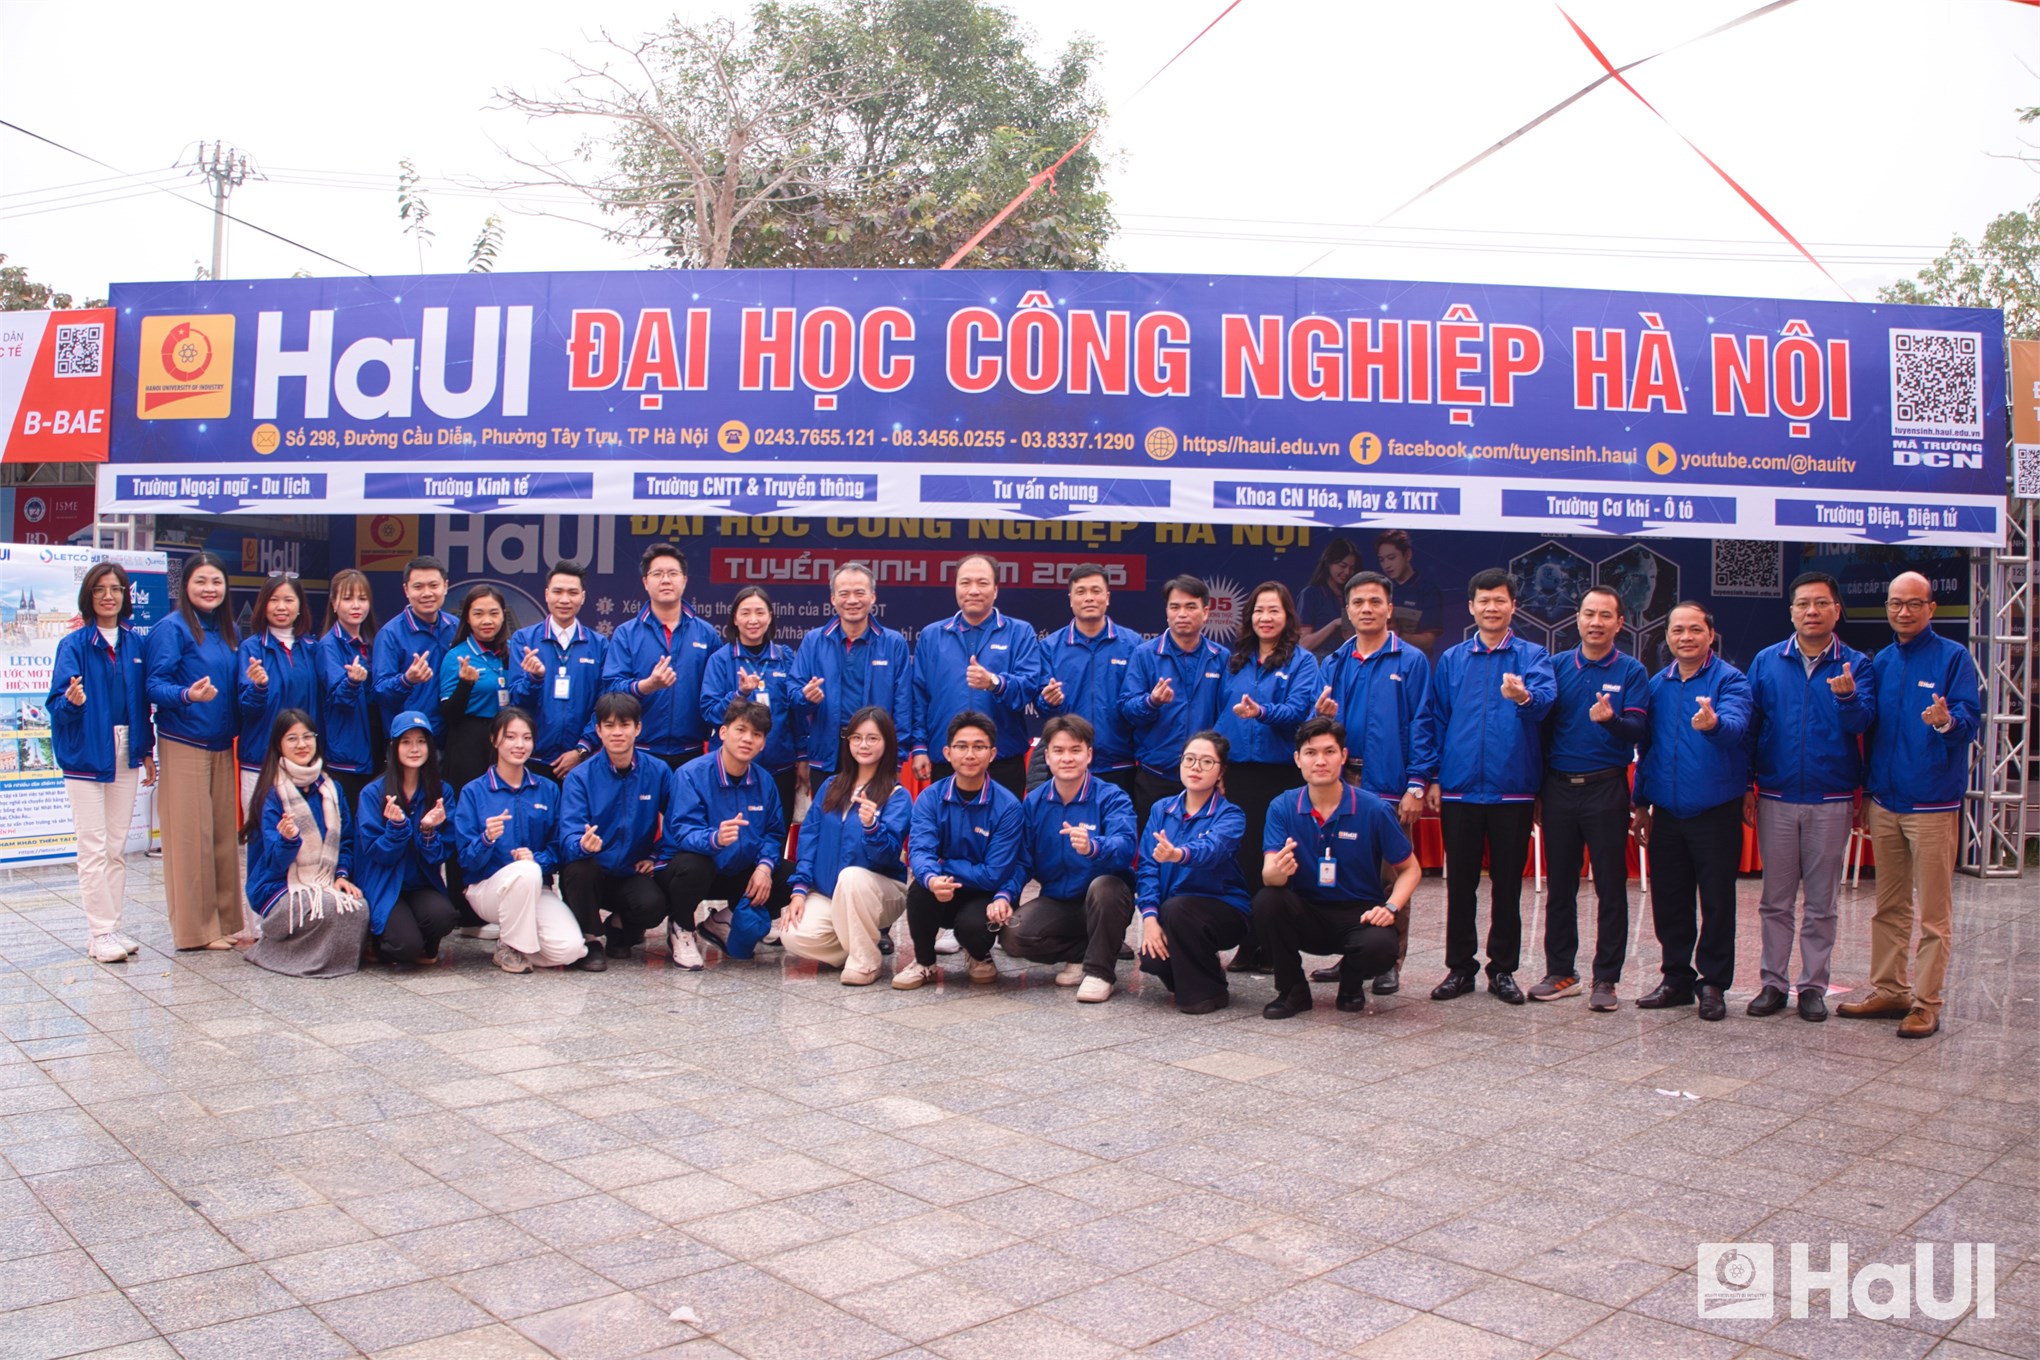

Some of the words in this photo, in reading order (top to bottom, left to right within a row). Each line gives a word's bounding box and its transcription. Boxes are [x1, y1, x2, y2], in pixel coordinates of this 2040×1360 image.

[253, 305, 533, 420] HaUI
[566, 308, 711, 410] ĐẠI
[738, 306, 915, 411] HỌC
[946, 290, 1191, 397] CÔNG
[1221, 303, 1544, 425] NGHIỆP
[1572, 311, 1688, 414] HÀ
[1711, 319, 1851, 438] NỘI
[23, 409, 104, 435] B-BAE
[1894, 426, 1980, 438] tuyensinh.haui.edu.vn
[285, 427, 306, 446] Số
[309, 430, 340, 448] 298,
[344, 428, 398, 449] Đường
[402, 426, 433, 446] Cầu
[437, 426, 477, 447] Diễn,
[482, 427, 547, 448] Phường
[552, 428, 581, 449] Tây
[584, 426, 622, 448] Tựu,
[628, 428, 650, 444] TP
[654, 427, 674, 445] Hà
[680, 427, 709, 448] Nội
[754, 429, 875, 446] 0243.7655.121
[891, 430, 1005, 447] 08.3456.0255
[1021, 431, 1134, 451] 03.8337.1290
[1183, 435, 1340, 457] https//haui.edu.vn
[1387, 438, 1637, 465] facebook.com/tuyensinh.haui
[1893, 451, 1983, 470] DCN
[1681, 452, 1856, 476] youtube.com/@hauitv
[132, 478, 178, 498] Trường
[181, 478, 219, 499] Ngoại
[223, 477, 250, 497] ngữ
[261, 477, 282, 495] Du
[284, 477, 310, 499] lịch
[424, 478, 473, 498] Trường
[477, 477, 510, 496] Kinh
[514, 474, 531, 496] tế
[646, 476, 698, 498] Trường
[703, 478, 742, 496] CNTT
[746, 478, 759, 496] &
[763, 475, 815, 499] Truyền
[819, 478, 865, 499] thông
[993, 480, 1013, 500] Tư
[1016, 477, 1045, 500] vấn
[1049, 481, 1098, 503] chung
[1236, 486, 1277, 506] Khoa
[1280, 487, 1304, 507] CN
[1307, 486, 1343, 510] Hóa,
[1347, 489, 1380, 511] May
[1384, 490, 1397, 509] &
[1401, 491, 1438, 511] TKTT
[1547, 496, 1598, 518] Trường
[1602, 497, 1623, 517] Cơ
[1626, 497, 1650, 518] khí
[1664, 497, 1677, 518] Ô
[1679, 500, 1693, 519] tô
[1816, 504, 1864, 527] Trường
[1867, 507, 1904, 529] Điện,
[1907, 507, 1939, 530] Điện
[1943, 510, 1958, 528] tử
[54, 554, 88, 562] LETCO
[10, 656, 52, 666] LETCO
